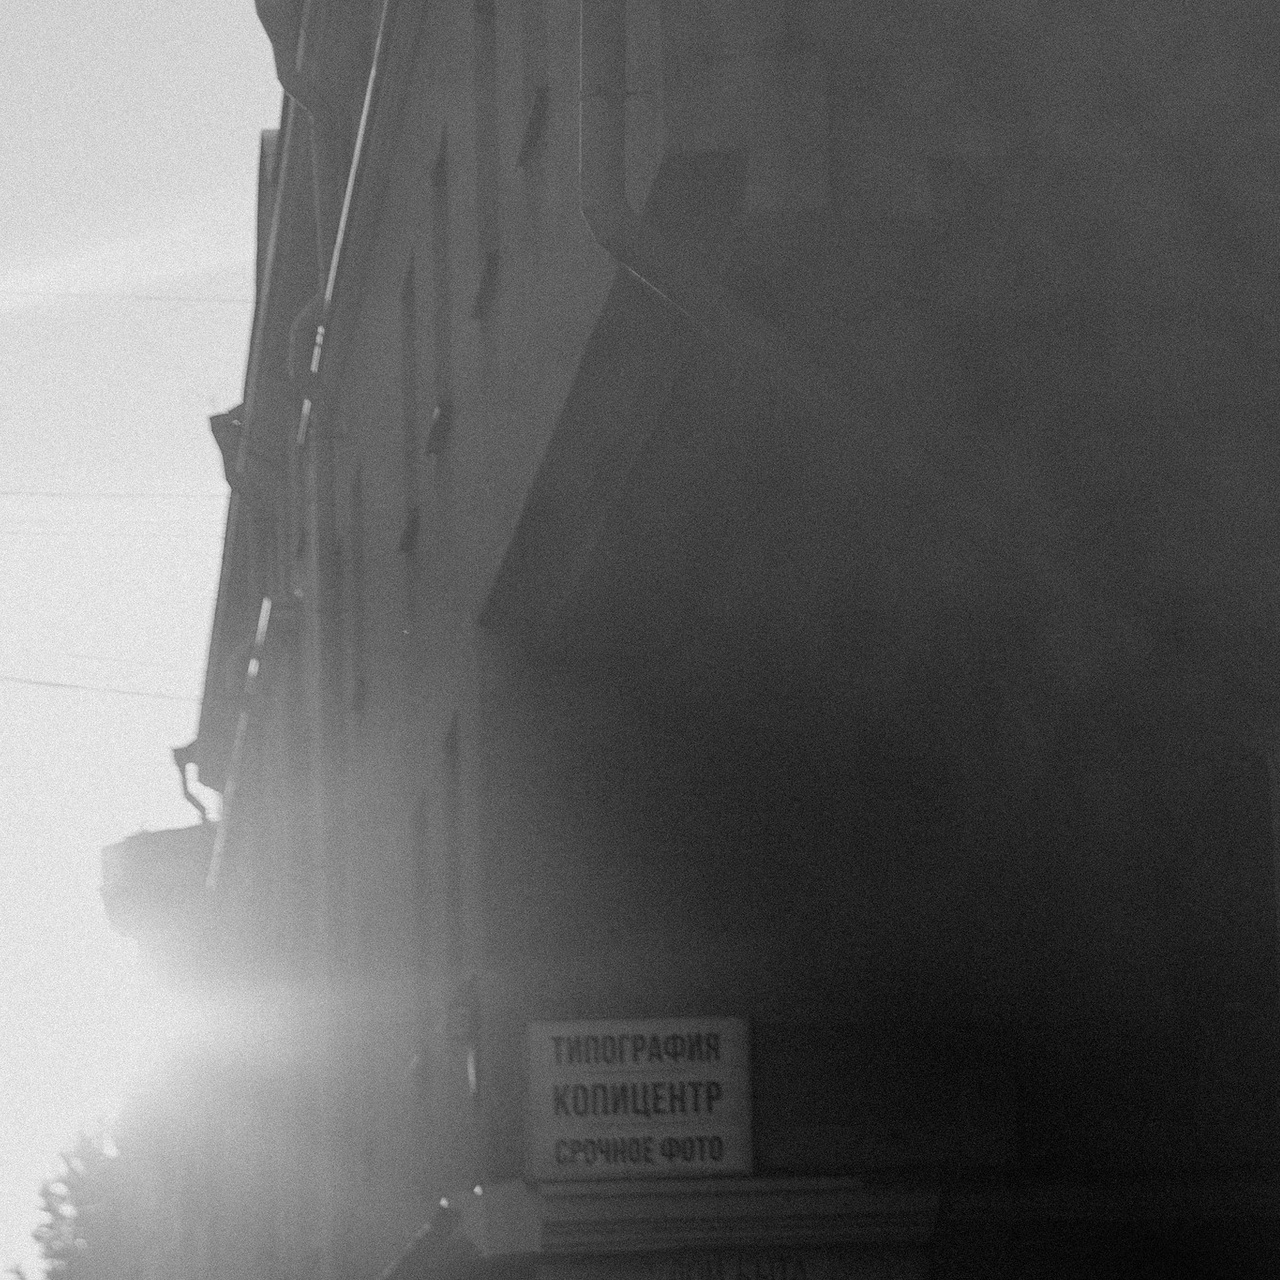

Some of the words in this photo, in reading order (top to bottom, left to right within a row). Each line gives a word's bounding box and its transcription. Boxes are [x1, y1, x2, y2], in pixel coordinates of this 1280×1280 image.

[551, 1033, 720, 1064] ТИПОГРАФИЯ
[553, 1080, 723, 1118] КОПИЦЕНТР
[555, 1136, 655, 1165] СРОЧНОЕ
[659, 1134, 724, 1162] ФОТО
